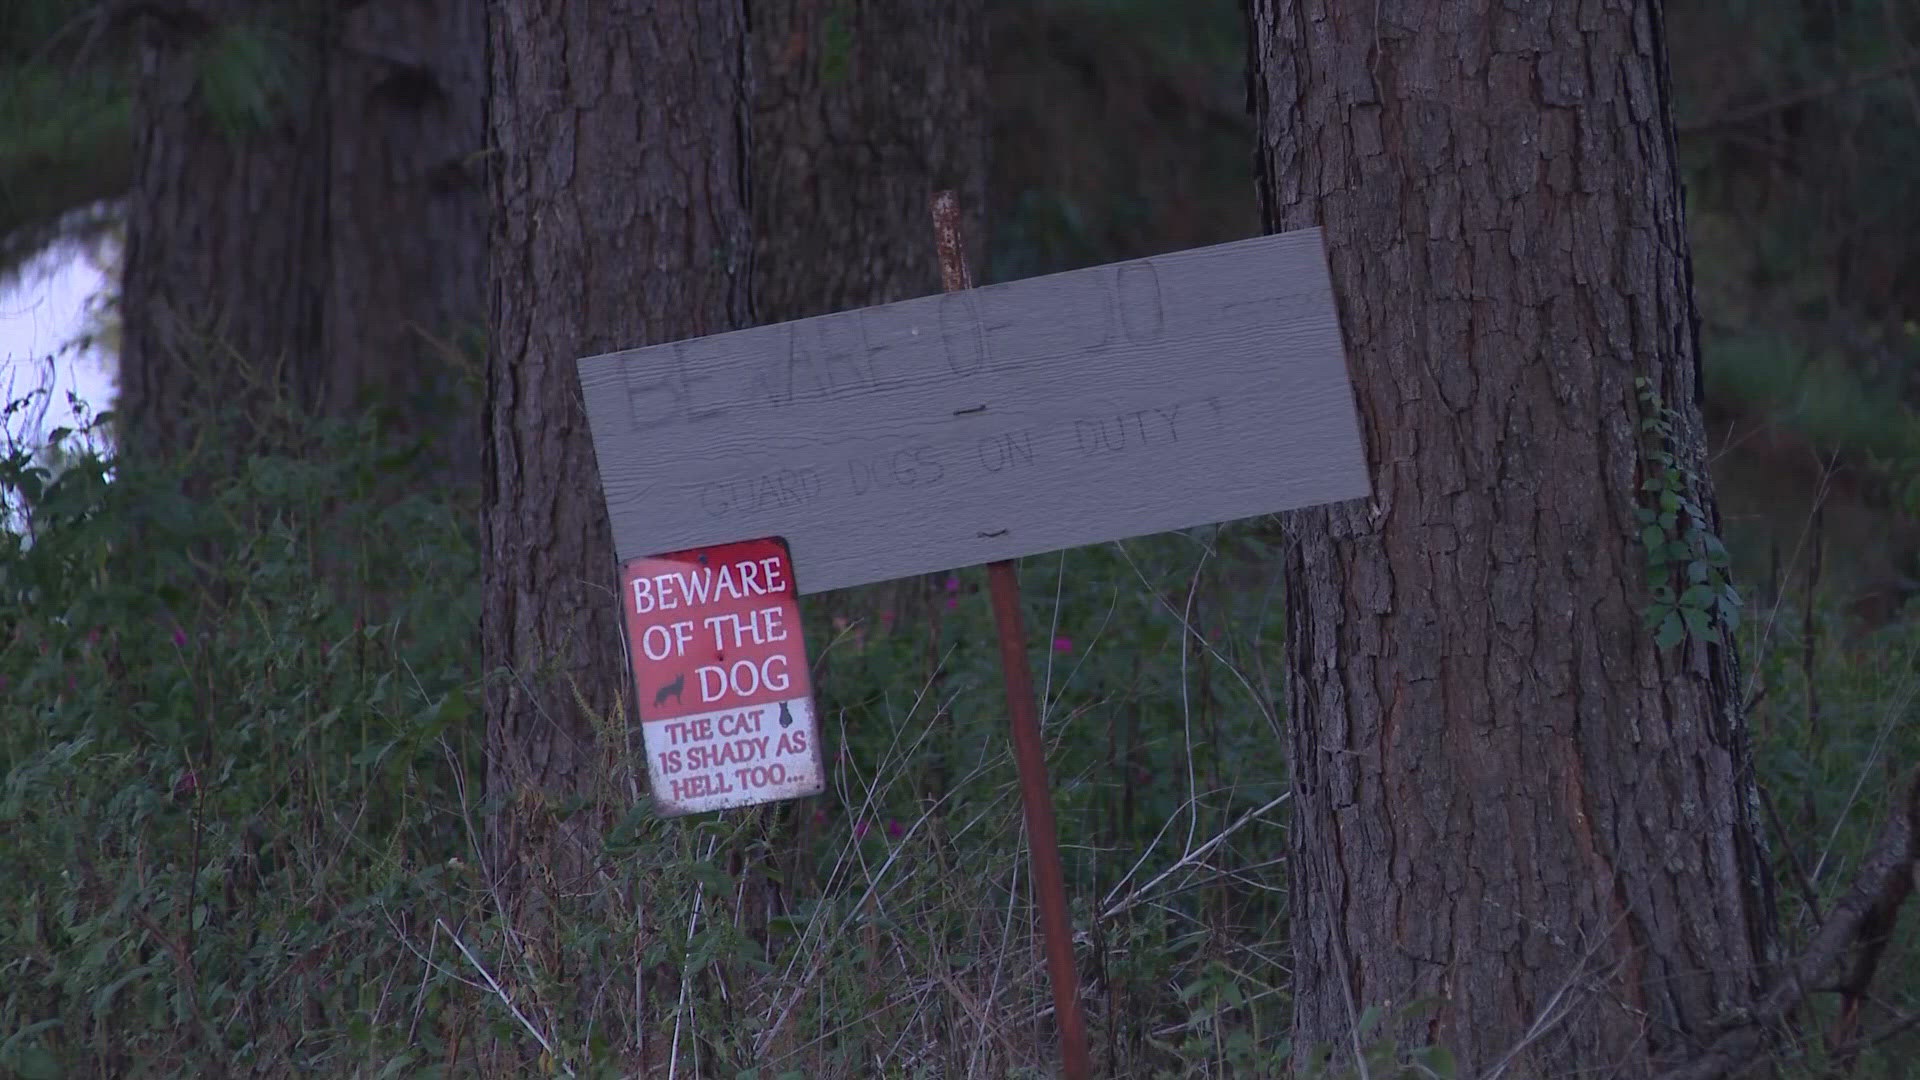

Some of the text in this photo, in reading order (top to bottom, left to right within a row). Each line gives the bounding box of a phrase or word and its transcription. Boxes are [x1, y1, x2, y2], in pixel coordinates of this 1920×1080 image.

[701, 466, 822, 520] GUARD
[847, 444, 945, 496] DOGS
[977, 430, 1034, 473] ON
[631, 557, 786, 614] BEWARE
[642, 607, 788, 661] OF THE
[695, 655, 790, 703] DOG
[664, 710, 765, 745] THE CAT
[658, 730, 808, 775] IS SHADY AS
[669, 763, 805, 801] HELL TOO...
